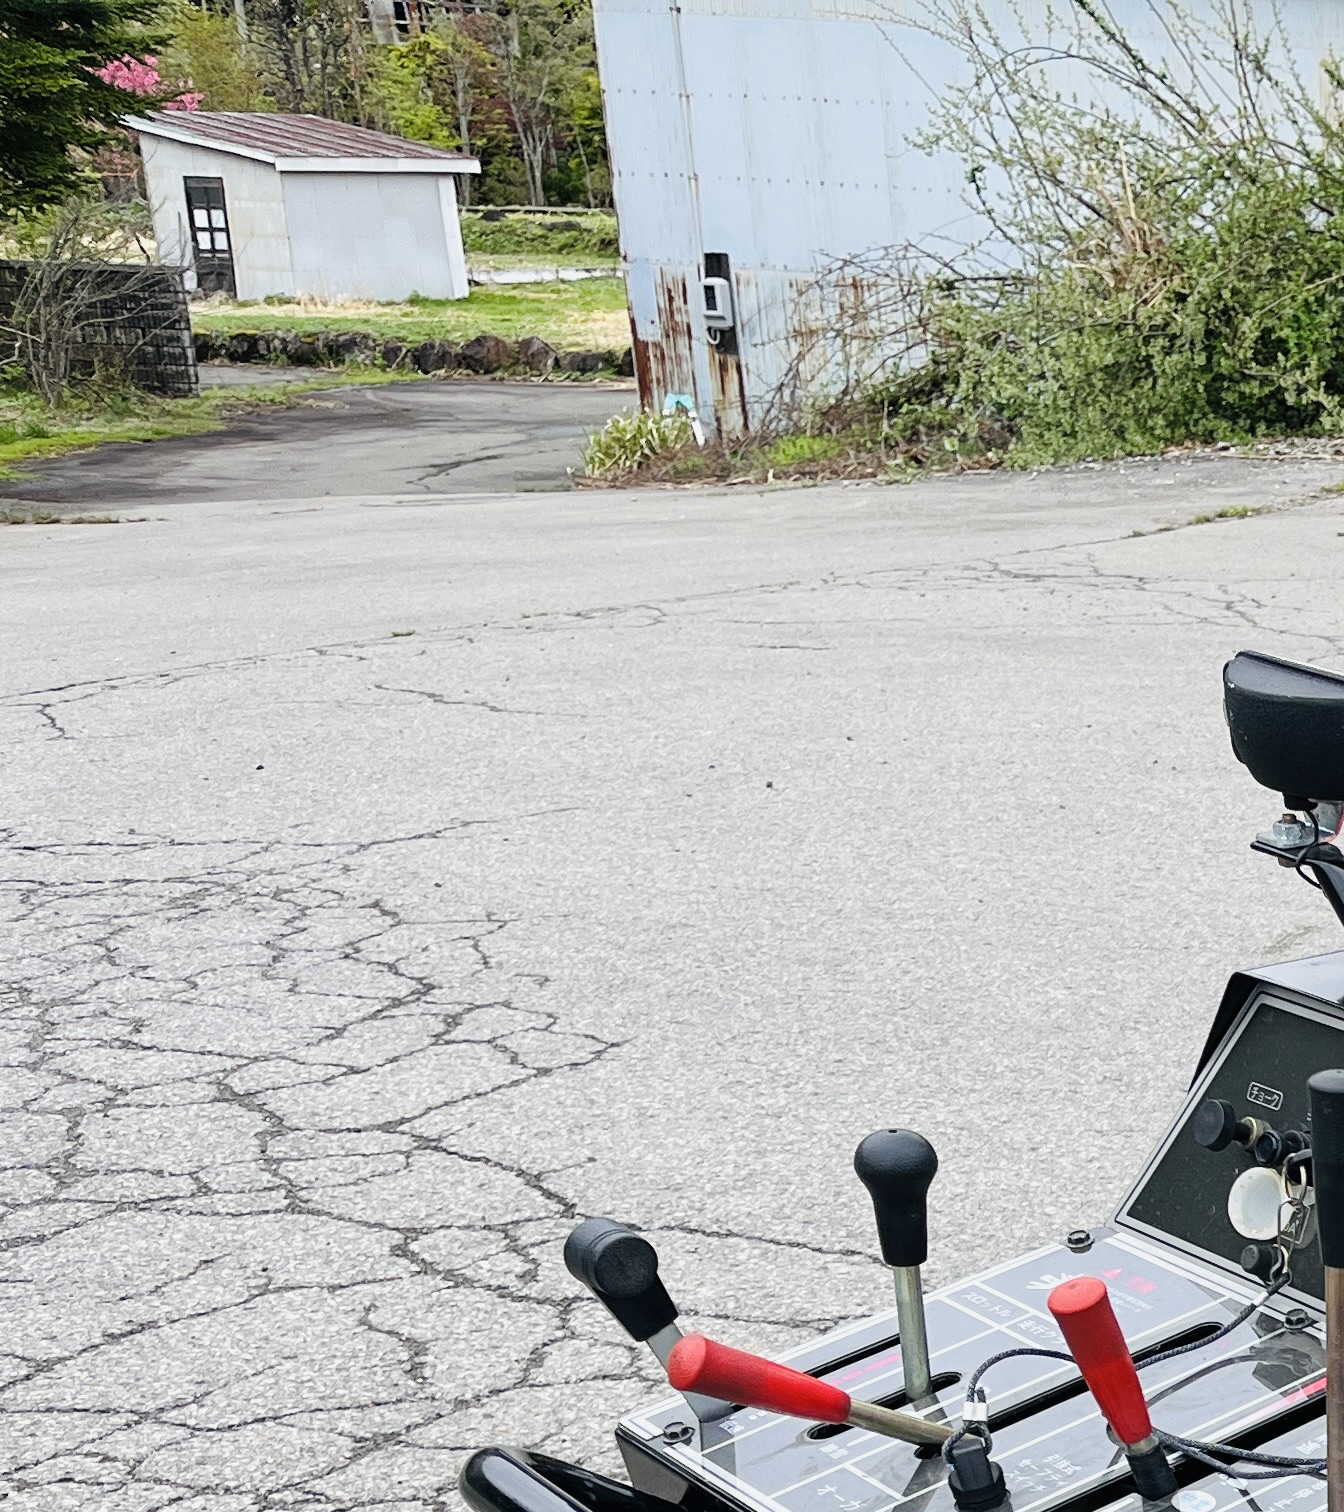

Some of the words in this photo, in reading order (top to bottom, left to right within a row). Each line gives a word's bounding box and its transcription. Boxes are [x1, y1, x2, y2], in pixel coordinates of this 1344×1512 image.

[1250, 1086, 1280, 1107] チョーク
[960, 1291, 1012, 1318] スロットル
[1004, 1469, 1047, 1494] スイッチ
[816, 1484, 864, 1511] オーガ
